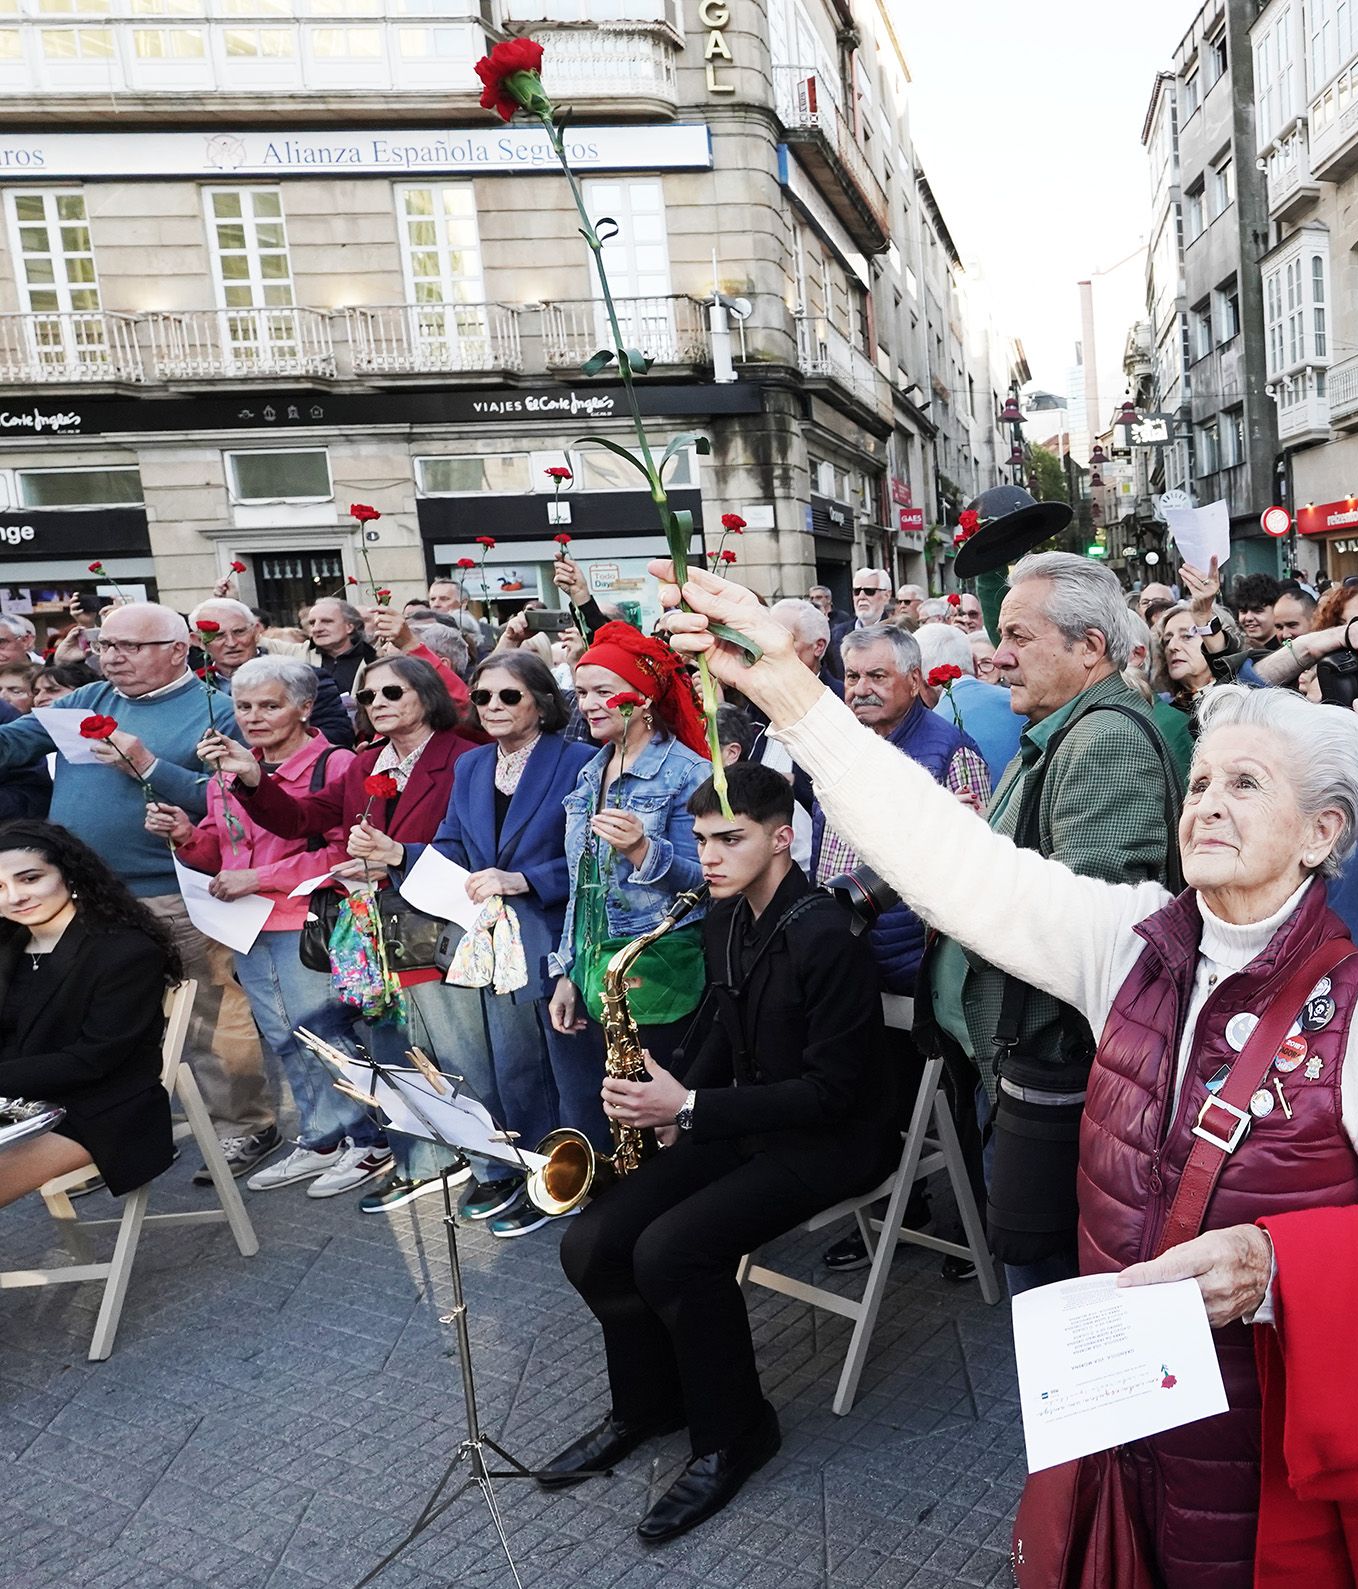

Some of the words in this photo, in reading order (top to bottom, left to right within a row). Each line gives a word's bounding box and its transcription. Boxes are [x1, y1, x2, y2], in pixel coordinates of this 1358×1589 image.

[0, 149, 45, 165] ros
[263, 141, 362, 165] Alianza
[371, 138, 489, 168] Española
[473, 401, 522, 413] VIAJES
[901, 515, 922, 523] GAES
